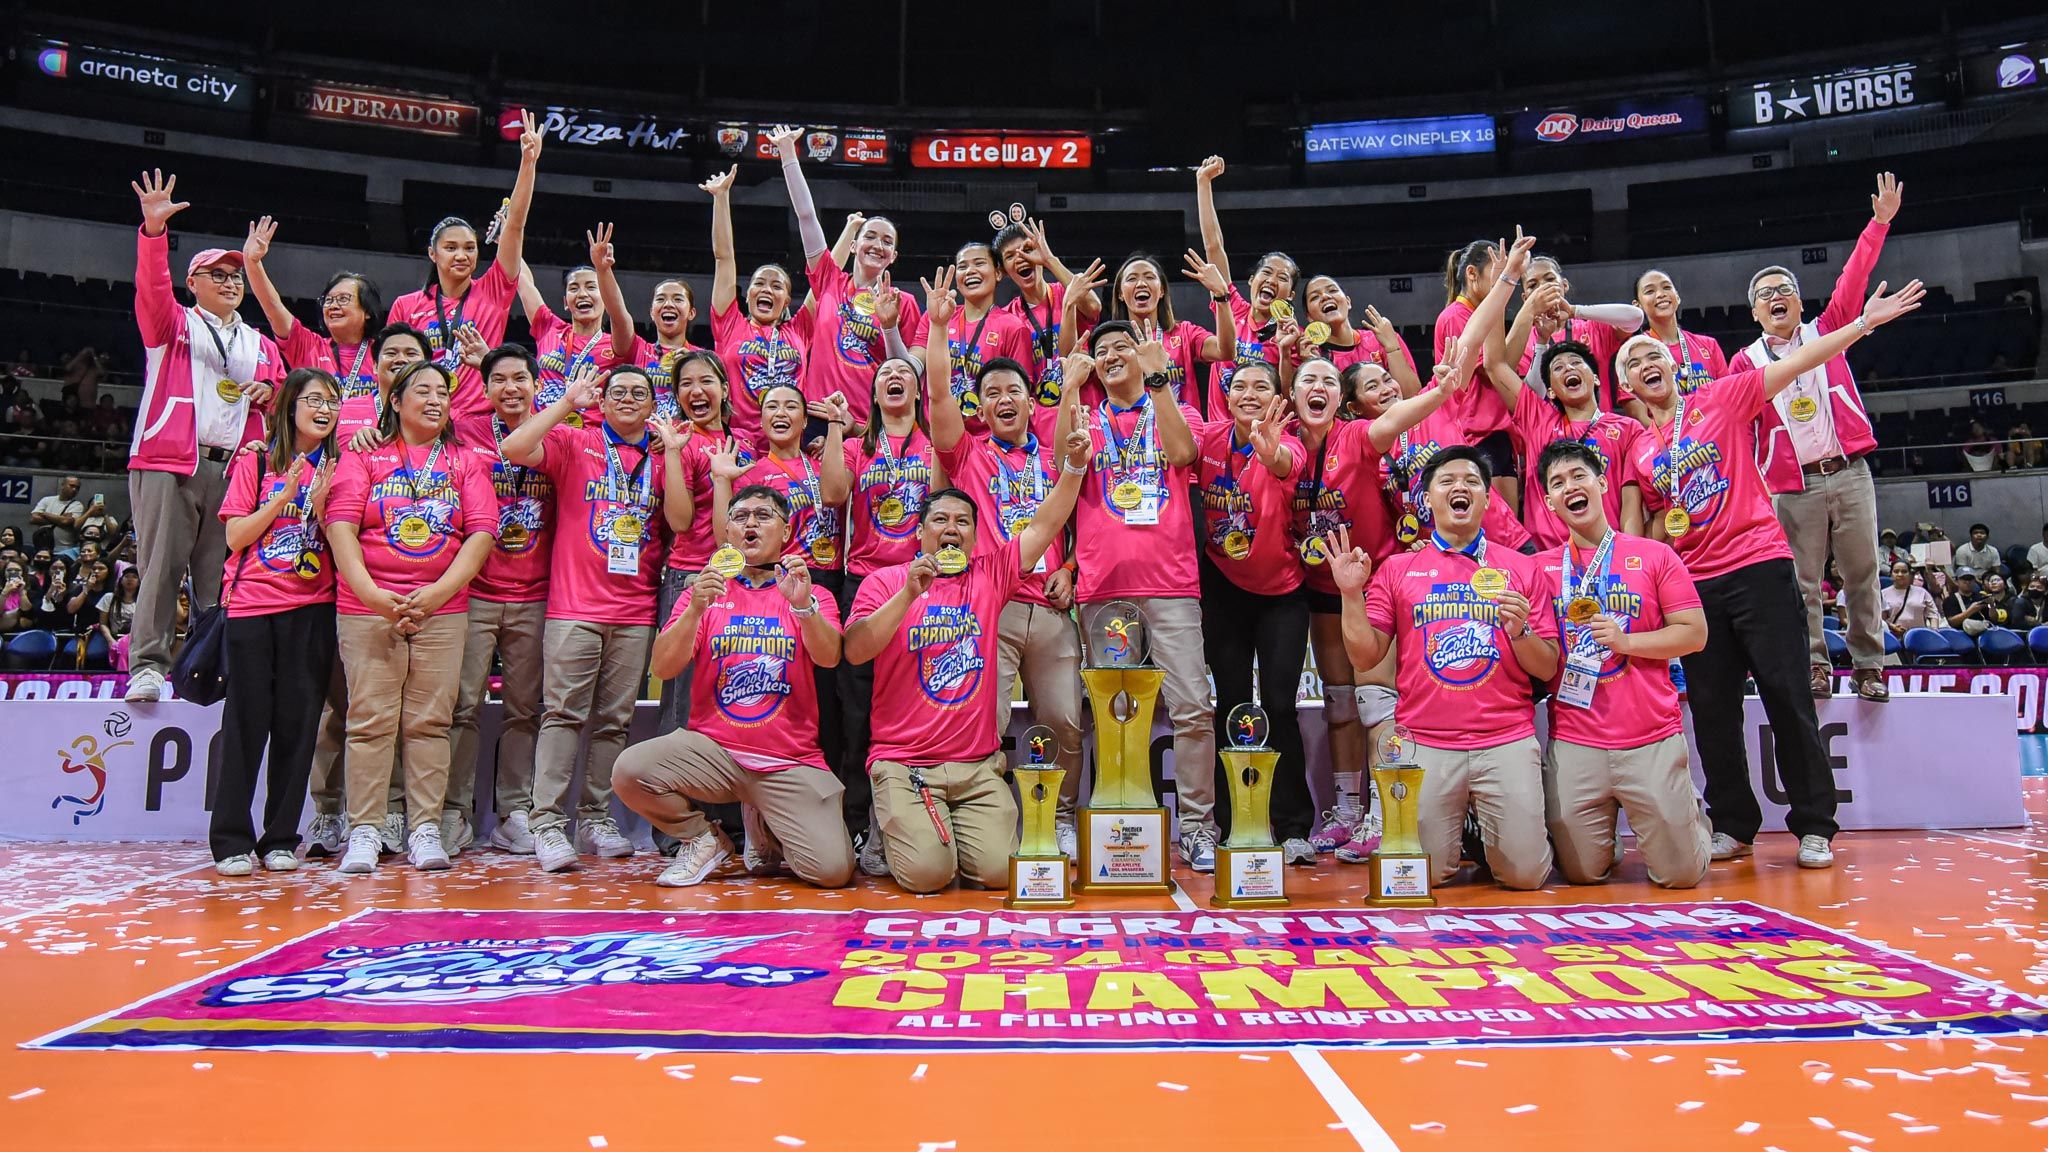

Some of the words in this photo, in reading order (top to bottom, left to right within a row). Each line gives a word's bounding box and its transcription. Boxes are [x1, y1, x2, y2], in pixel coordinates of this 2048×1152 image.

[80, 58, 178, 89] araneta
[187, 75, 237, 102] city
[297, 92, 460, 128] EMPERADOR
[540, 112, 624, 145] Pizza
[626, 121, 691, 149] Hut
[1544, 119, 1572, 135] DQ
[1581, 117, 1625, 132] Dairy
[1306, 134, 1387, 152] GATEWAY
[1390, 130, 1471, 147] CINEPLEX
[1475, 128, 1494, 143] 18
[847, 146, 883, 161] Cignal
[1061, 141, 1078, 163] 2
[1803, 249, 1826, 262] 219
[1244, 347, 1265, 360] SLAM
[1971, 391, 2004, 406] 116
[1677, 439, 1700, 459] SLAM
[1202, 456, 1220, 467] Allianz
[524, 474, 546, 483] SLAM
[1930, 484, 1968, 502] 116
[1606, 582, 1627, 592] LAM
[1425, 593, 1459, 603] GRAND
[923, 614, 953, 626] GRAND
[941, 607, 961, 615] 2024
[724, 625, 755, 636] GRAND
[759, 626, 784, 636] SLAM
[743, 617, 765, 625] 2024
[1435, 626, 1462, 641] Creamline
[1442, 628, 1475, 653] Cool
[711, 636, 796, 661] CHAMPIONS
[1431, 644, 1500, 670] Smashers
[726, 661, 754, 675] Creamline
[733, 663, 766, 689] Cool
[929, 656, 984, 692] Smashers
[721, 675, 791, 704] Smashers
[864, 908, 1767, 937] CONGRATULATIONS
[840, 949, 1120, 969] 2024
[1164, 946, 1517, 966] GRAND
[1542, 939, 1859, 962] SLAM
[220, 955, 814, 1002] Smashers
[832, 959, 1932, 1011] CHAMPIONS
[897, 1014, 982, 1028] ALL
[1000, 1011, 1198, 1027] FILIPINO
[1240, 1008, 1535, 1026] REINFORCED
[1570, 1000, 1902, 1020] INVITATIONAL
